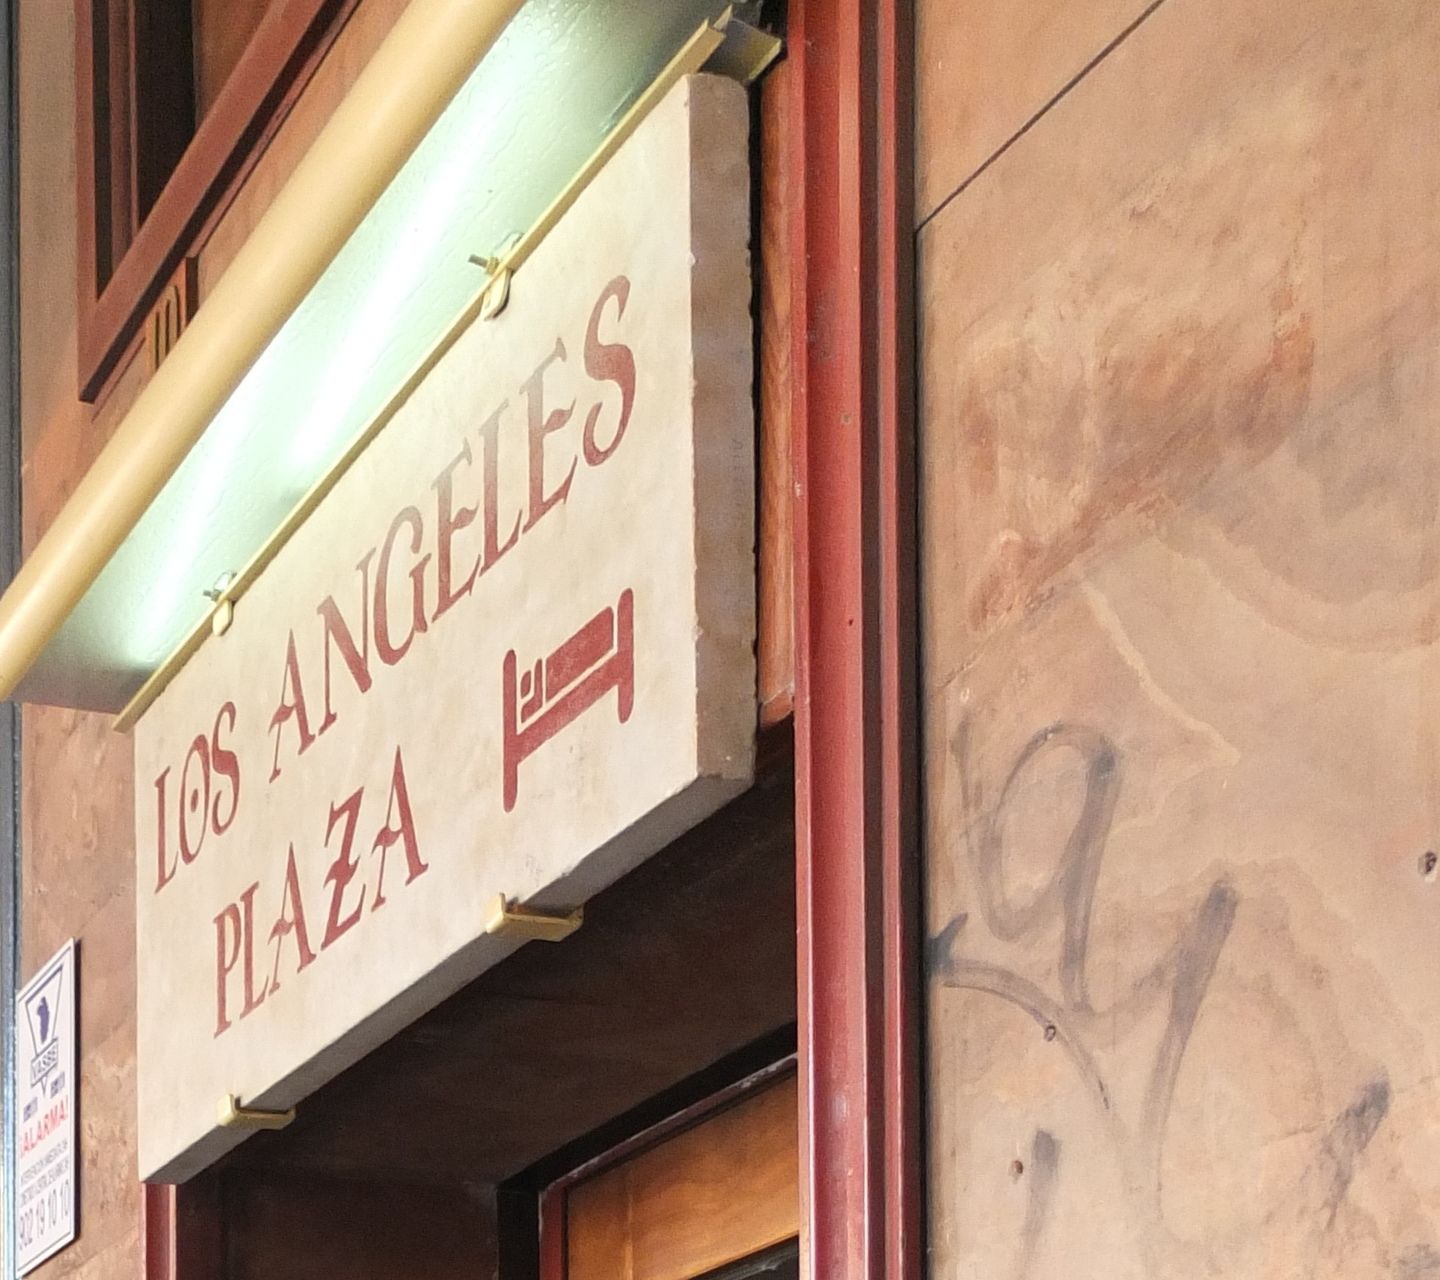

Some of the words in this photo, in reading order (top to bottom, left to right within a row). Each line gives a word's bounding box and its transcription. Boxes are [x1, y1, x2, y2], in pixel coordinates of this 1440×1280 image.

[154, 700, 241, 895] LOS
[268, 275, 638, 783] ANGELES
[212, 743, 429, 1037] PLAZA
